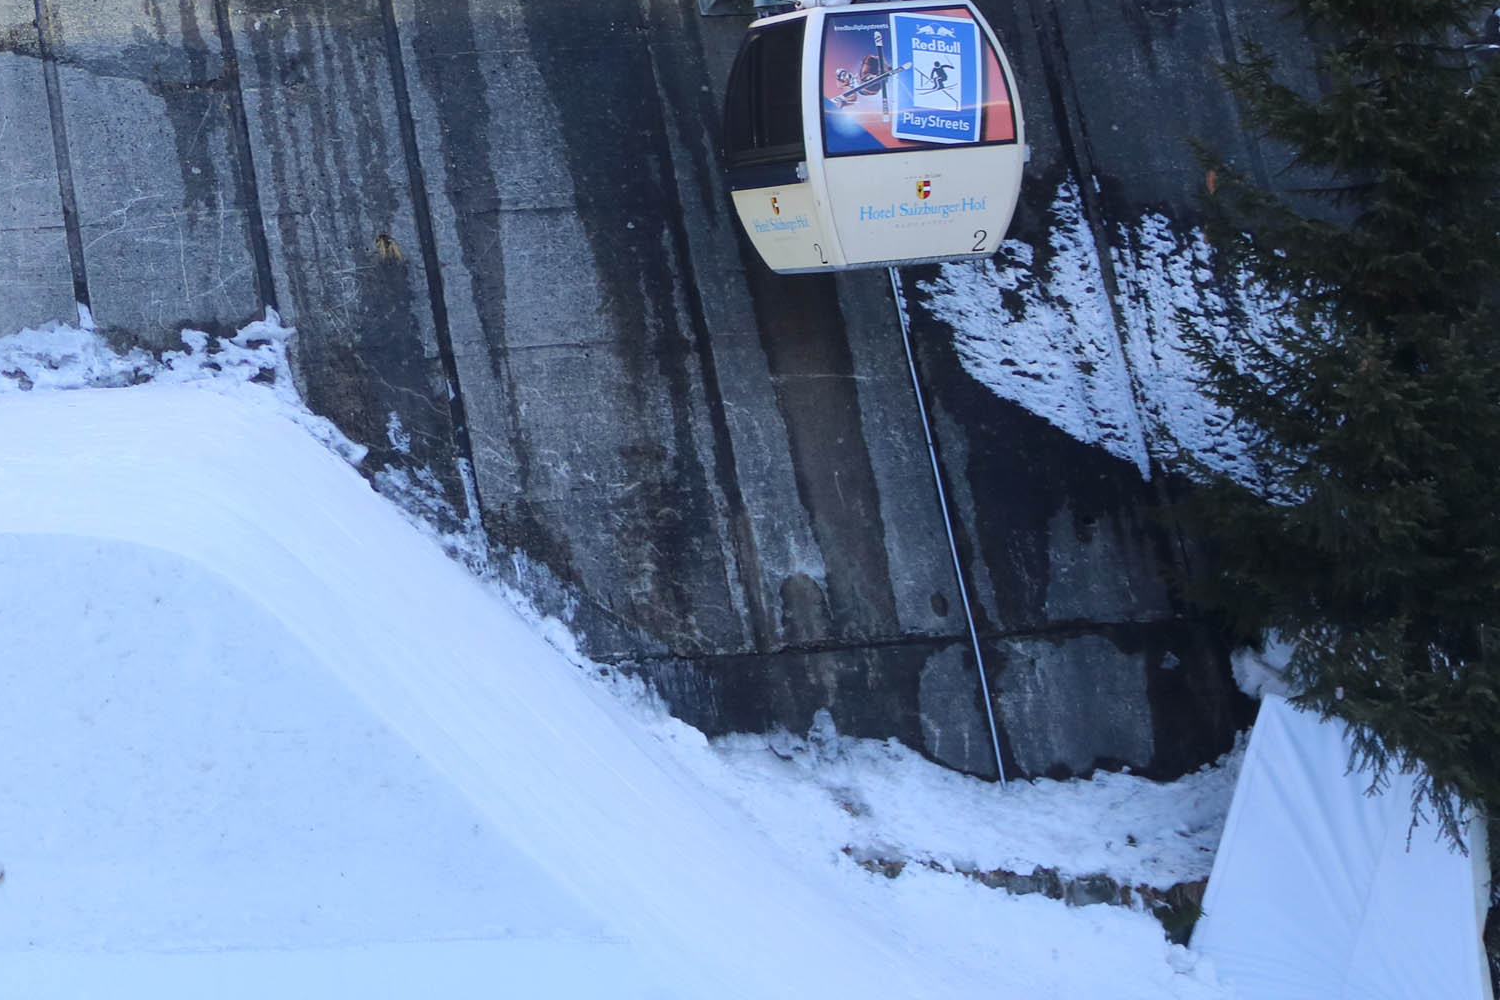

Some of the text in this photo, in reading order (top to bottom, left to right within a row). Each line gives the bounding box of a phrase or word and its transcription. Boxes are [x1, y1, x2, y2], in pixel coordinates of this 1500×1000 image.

[911, 38, 961, 53] Red Bull
[860, 196, 987, 221] Hotel Salzburger Hof
[971, 229, 988, 252] 2
